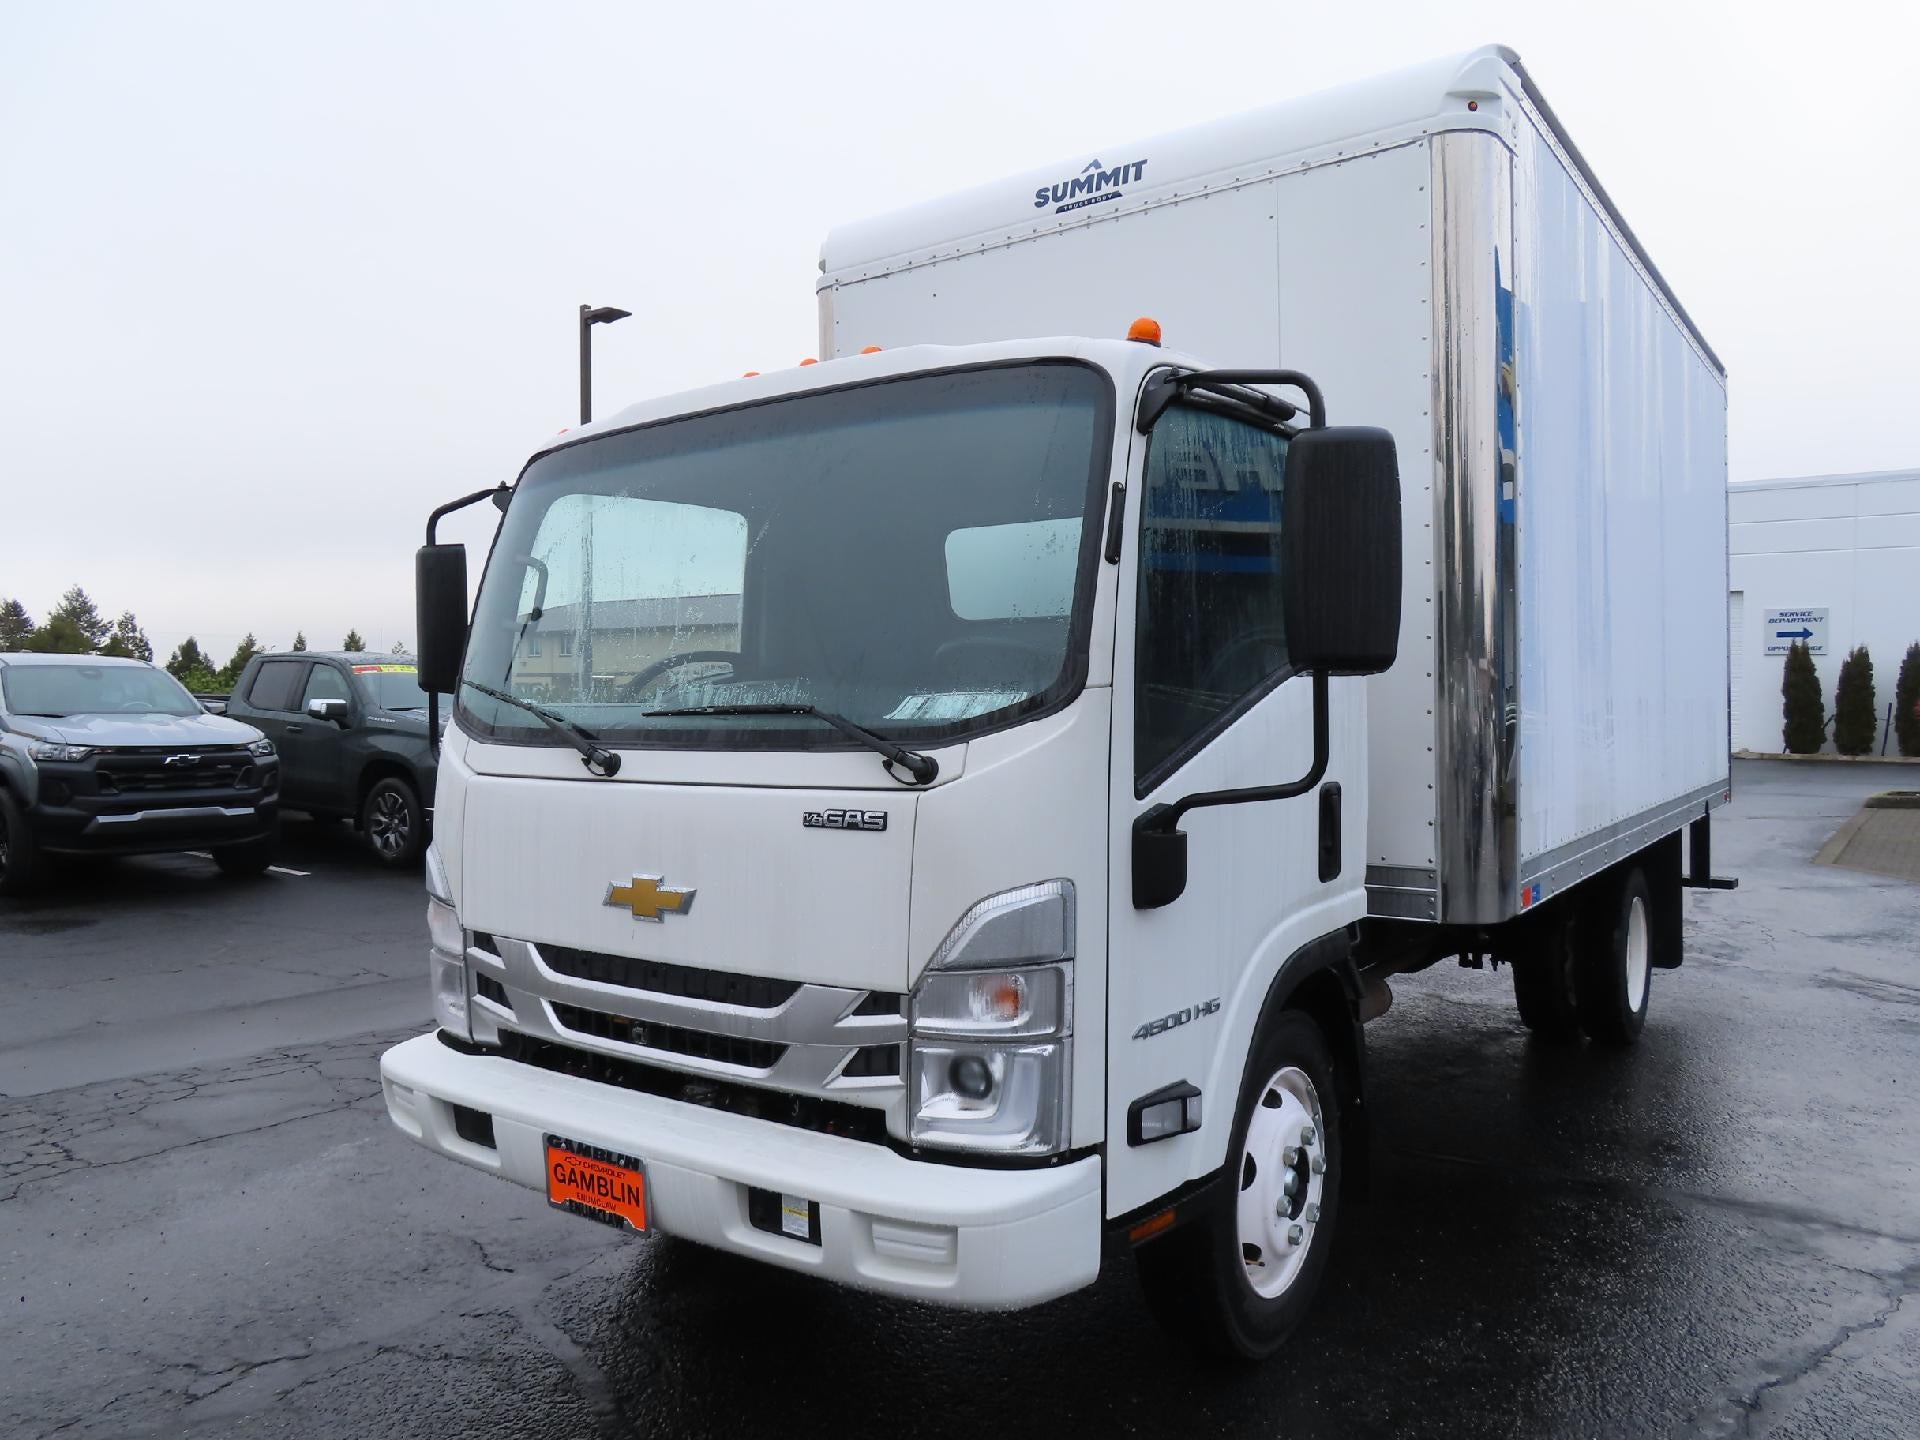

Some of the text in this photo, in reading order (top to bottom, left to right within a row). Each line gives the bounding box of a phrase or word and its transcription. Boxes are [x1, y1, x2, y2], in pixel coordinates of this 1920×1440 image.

[1034, 159, 1148, 209] SUMMIT
[1063, 194, 1114, 211] TRUCK BODY
[823, 809, 887, 831] GAS
[583, 1161, 626, 1180] CHEVROLET
[553, 1163, 640, 1208] GAMBLIN
[576, 1191, 617, 1212] ENUMCLAW
